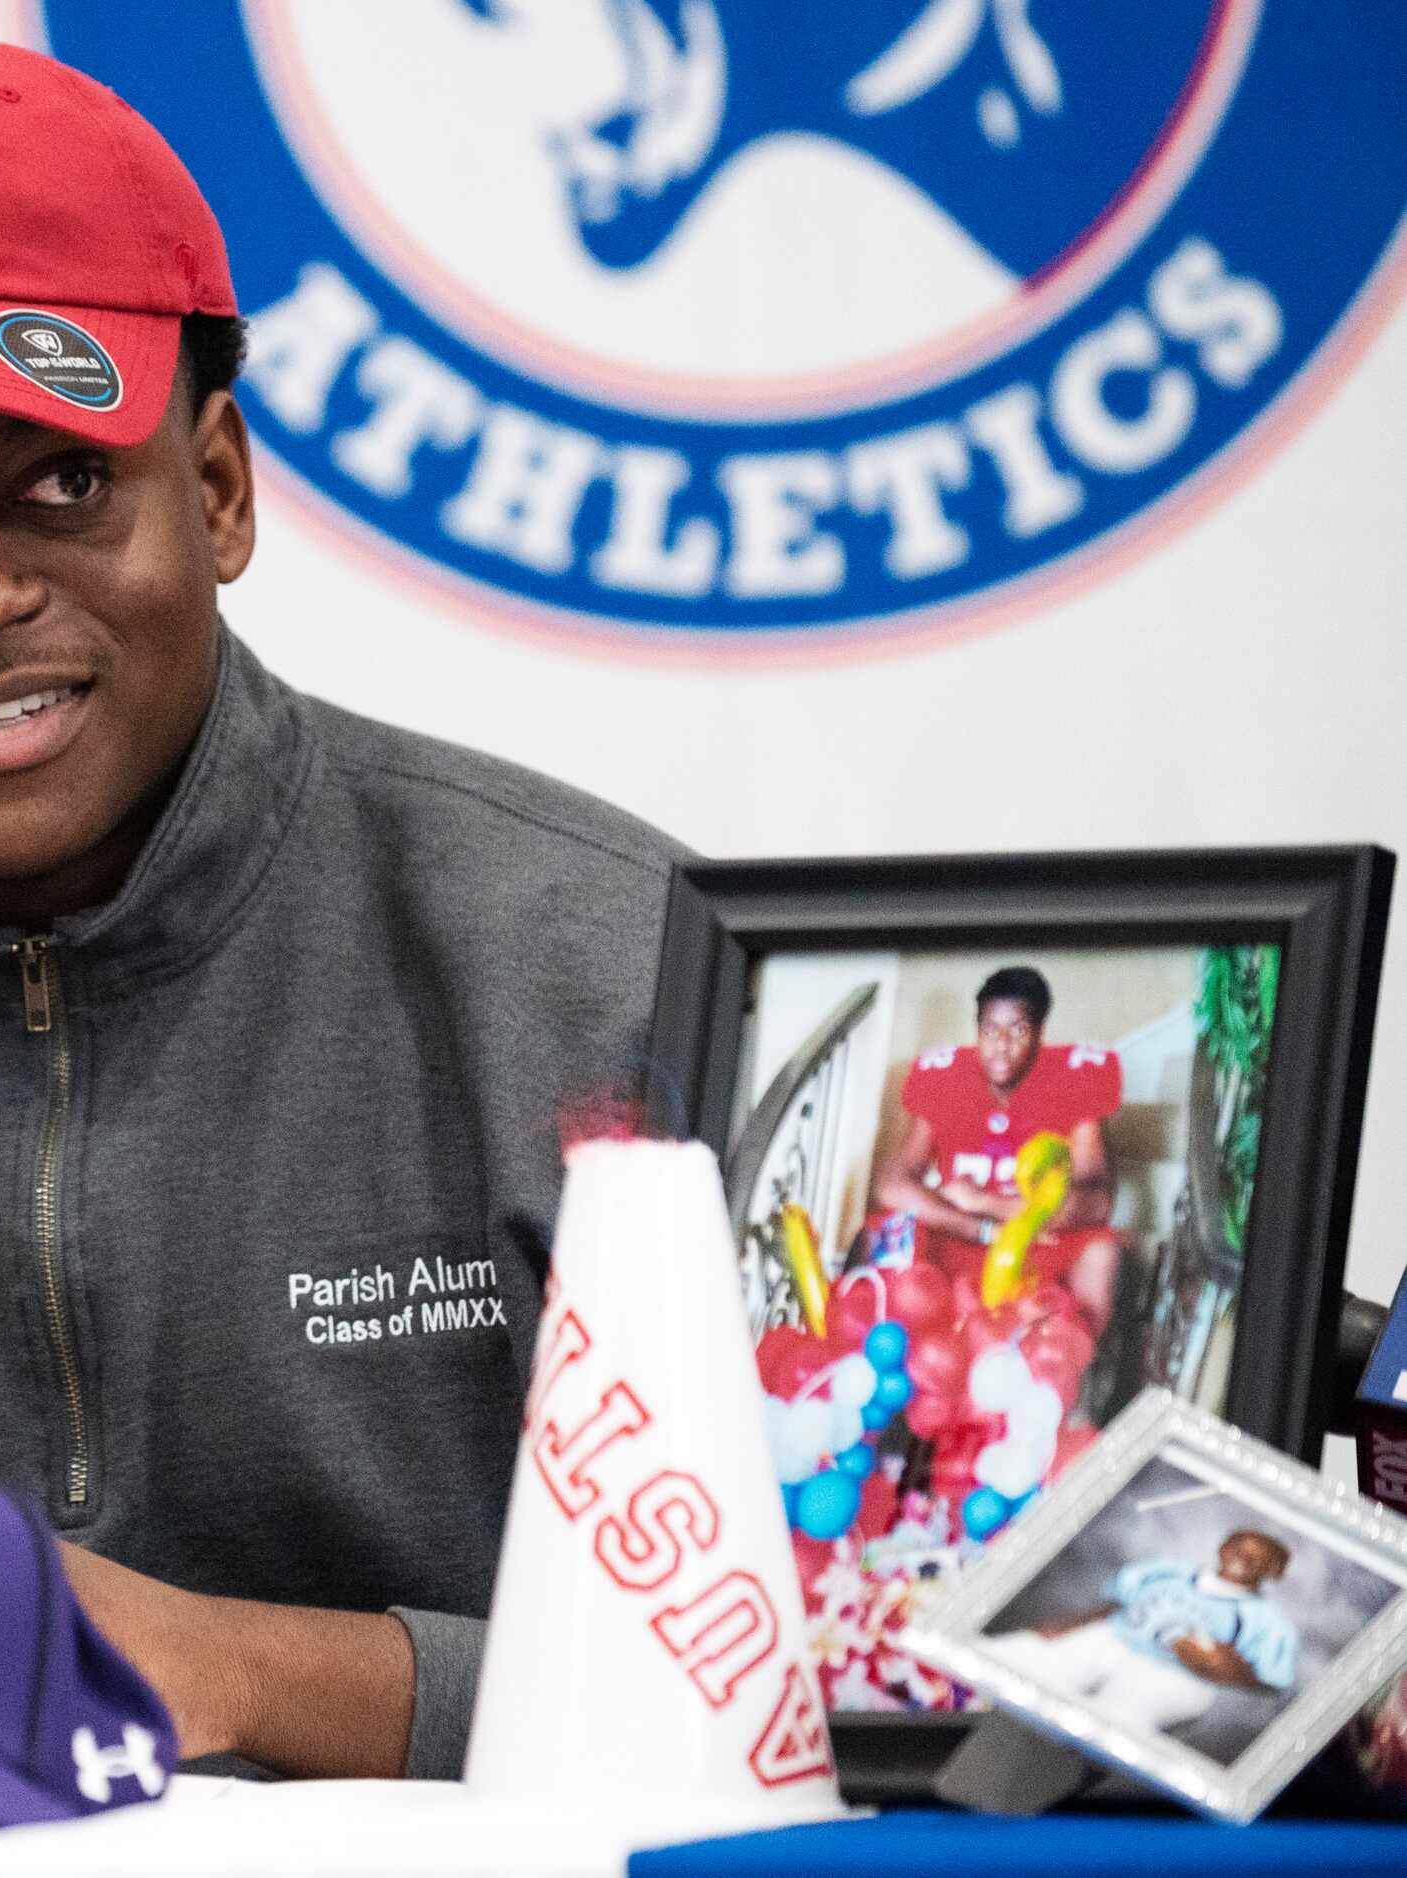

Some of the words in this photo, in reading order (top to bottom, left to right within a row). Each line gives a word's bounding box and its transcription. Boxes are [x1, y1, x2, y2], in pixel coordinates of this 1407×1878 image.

[240, 237, 1284, 599] ATHLETICS
[288, 1263, 395, 1310] Parish
[408, 1255, 497, 1297] Alum
[305, 1314, 383, 1345] Class
[388, 1304, 413, 1336] of
[421, 1296, 508, 1334] MMXX
[526, 1262, 832, 1788] AUSTI
